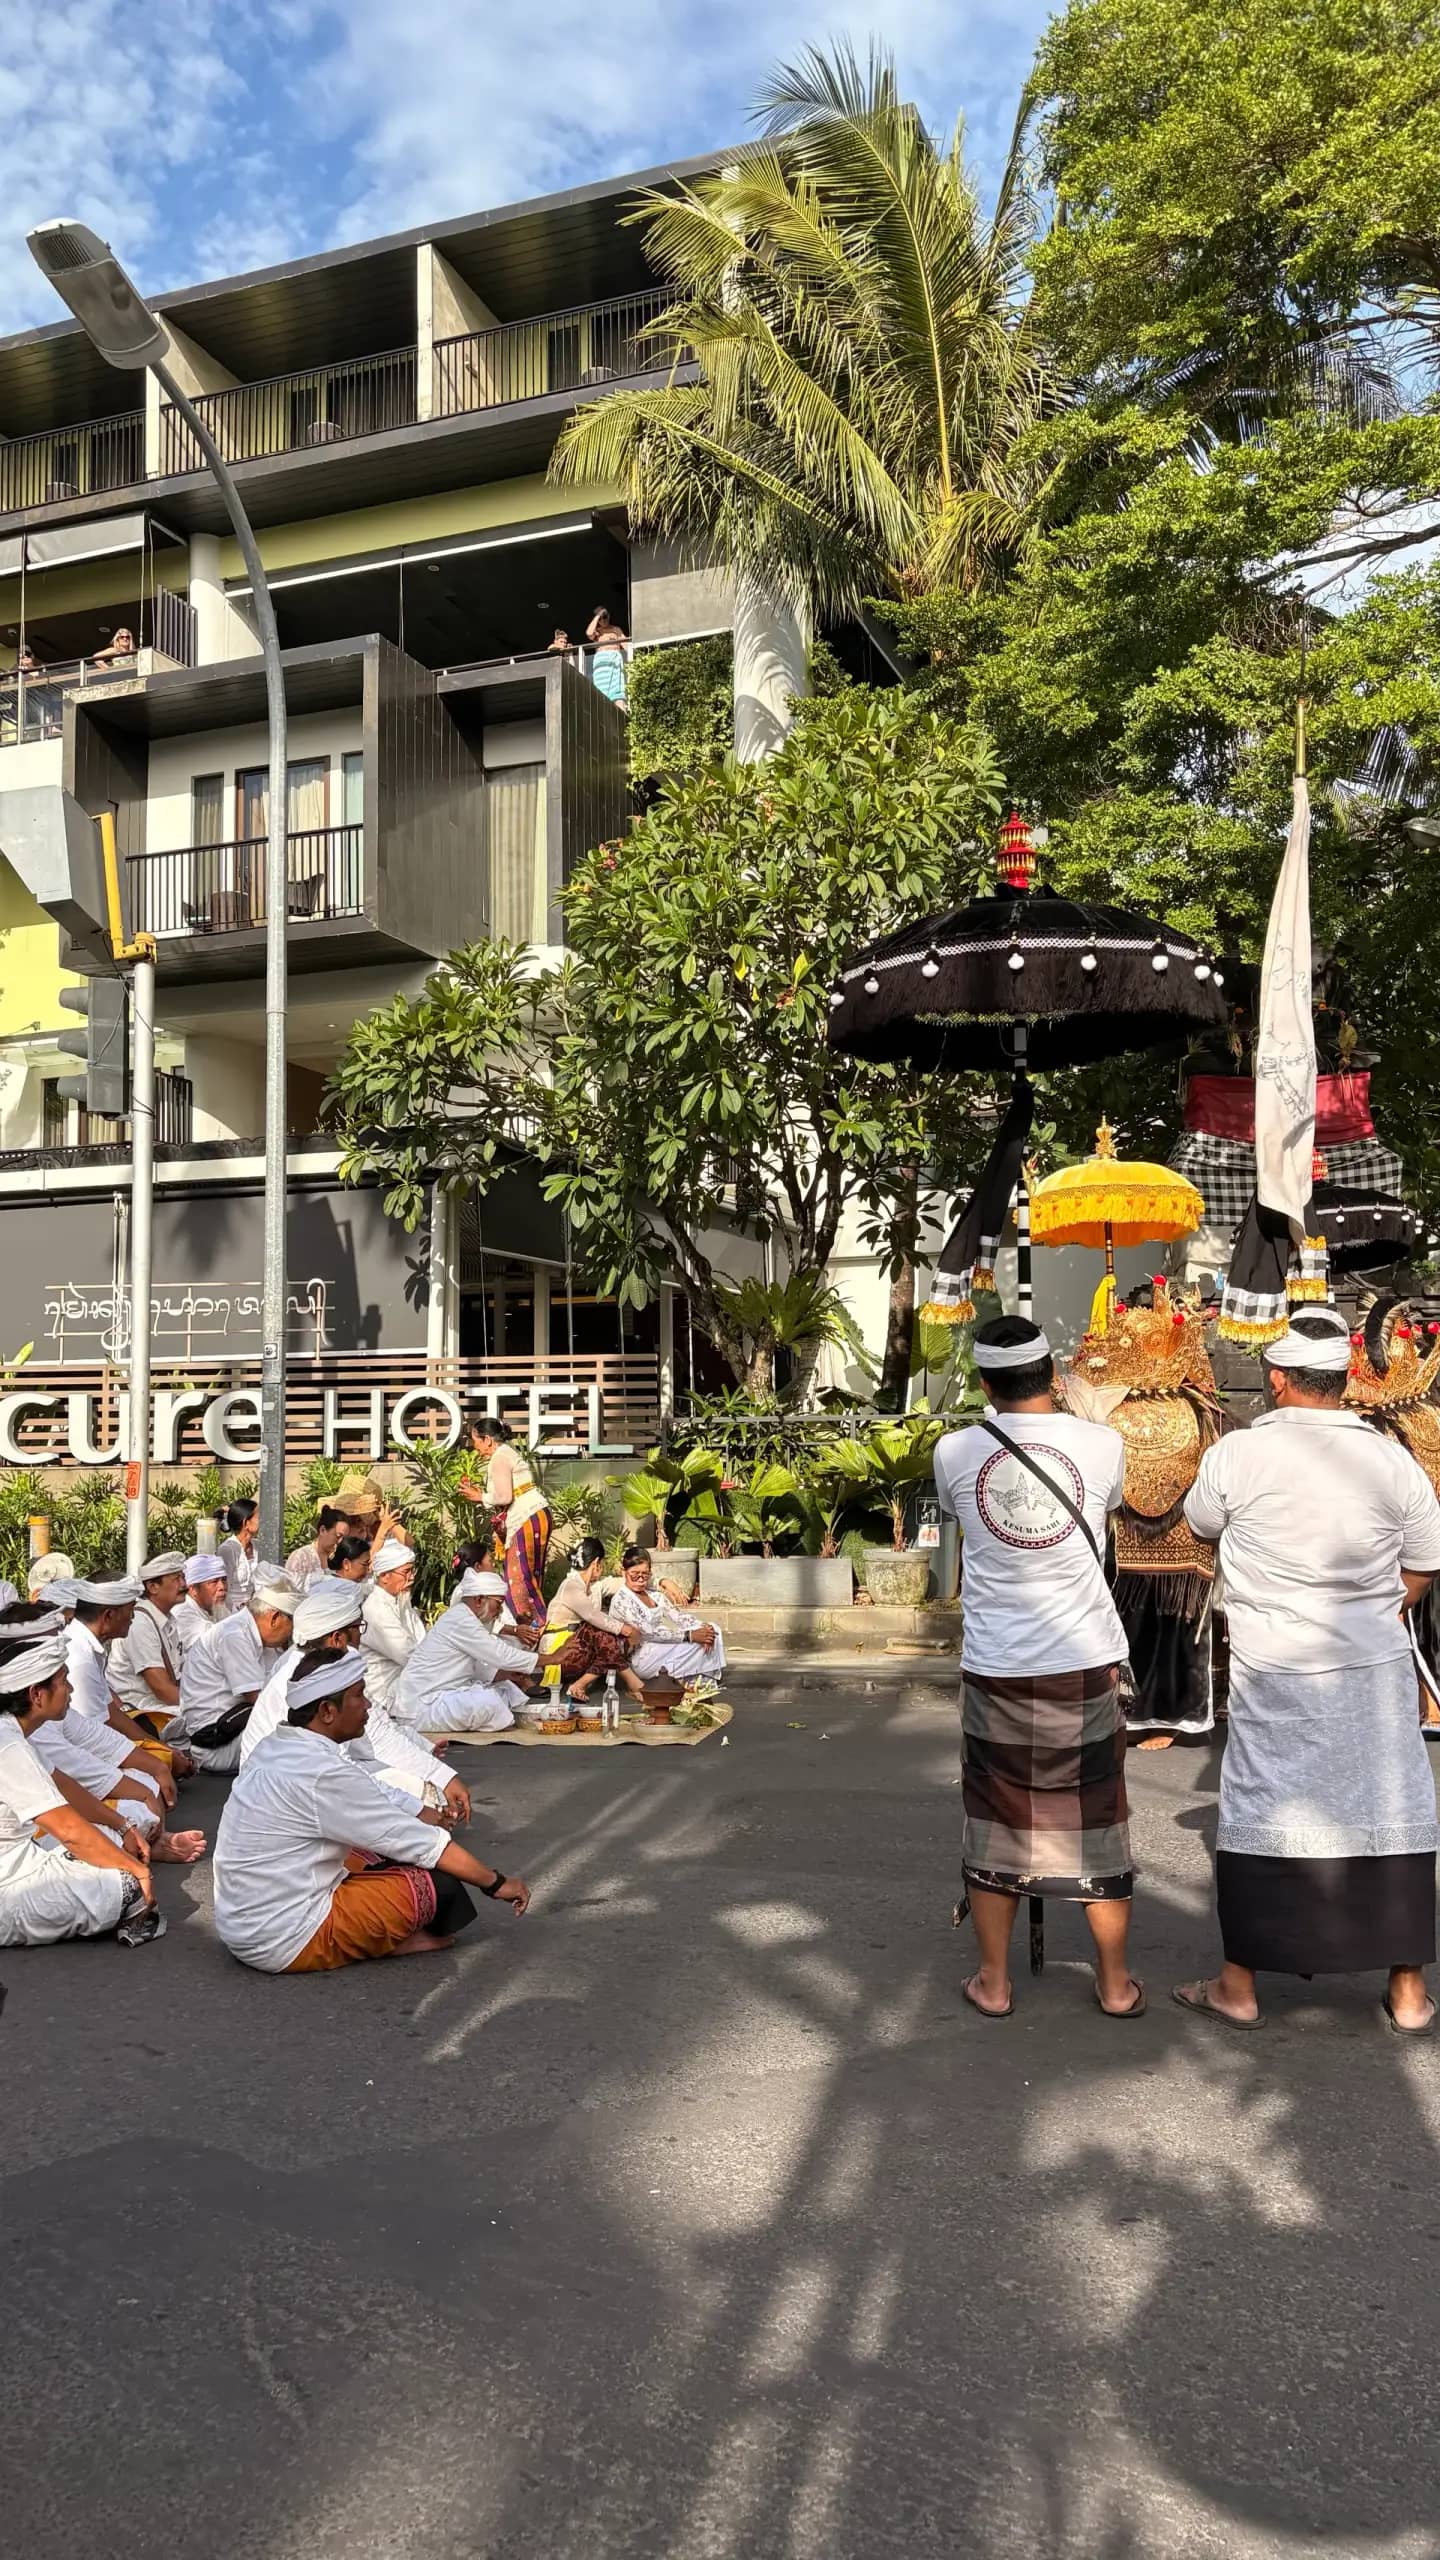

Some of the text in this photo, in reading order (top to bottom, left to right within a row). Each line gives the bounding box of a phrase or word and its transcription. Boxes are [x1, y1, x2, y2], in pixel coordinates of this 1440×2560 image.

[0, 1384, 634, 1464] cure HOTEL
[1003, 1519, 1061, 1534] KESUMA SARI
